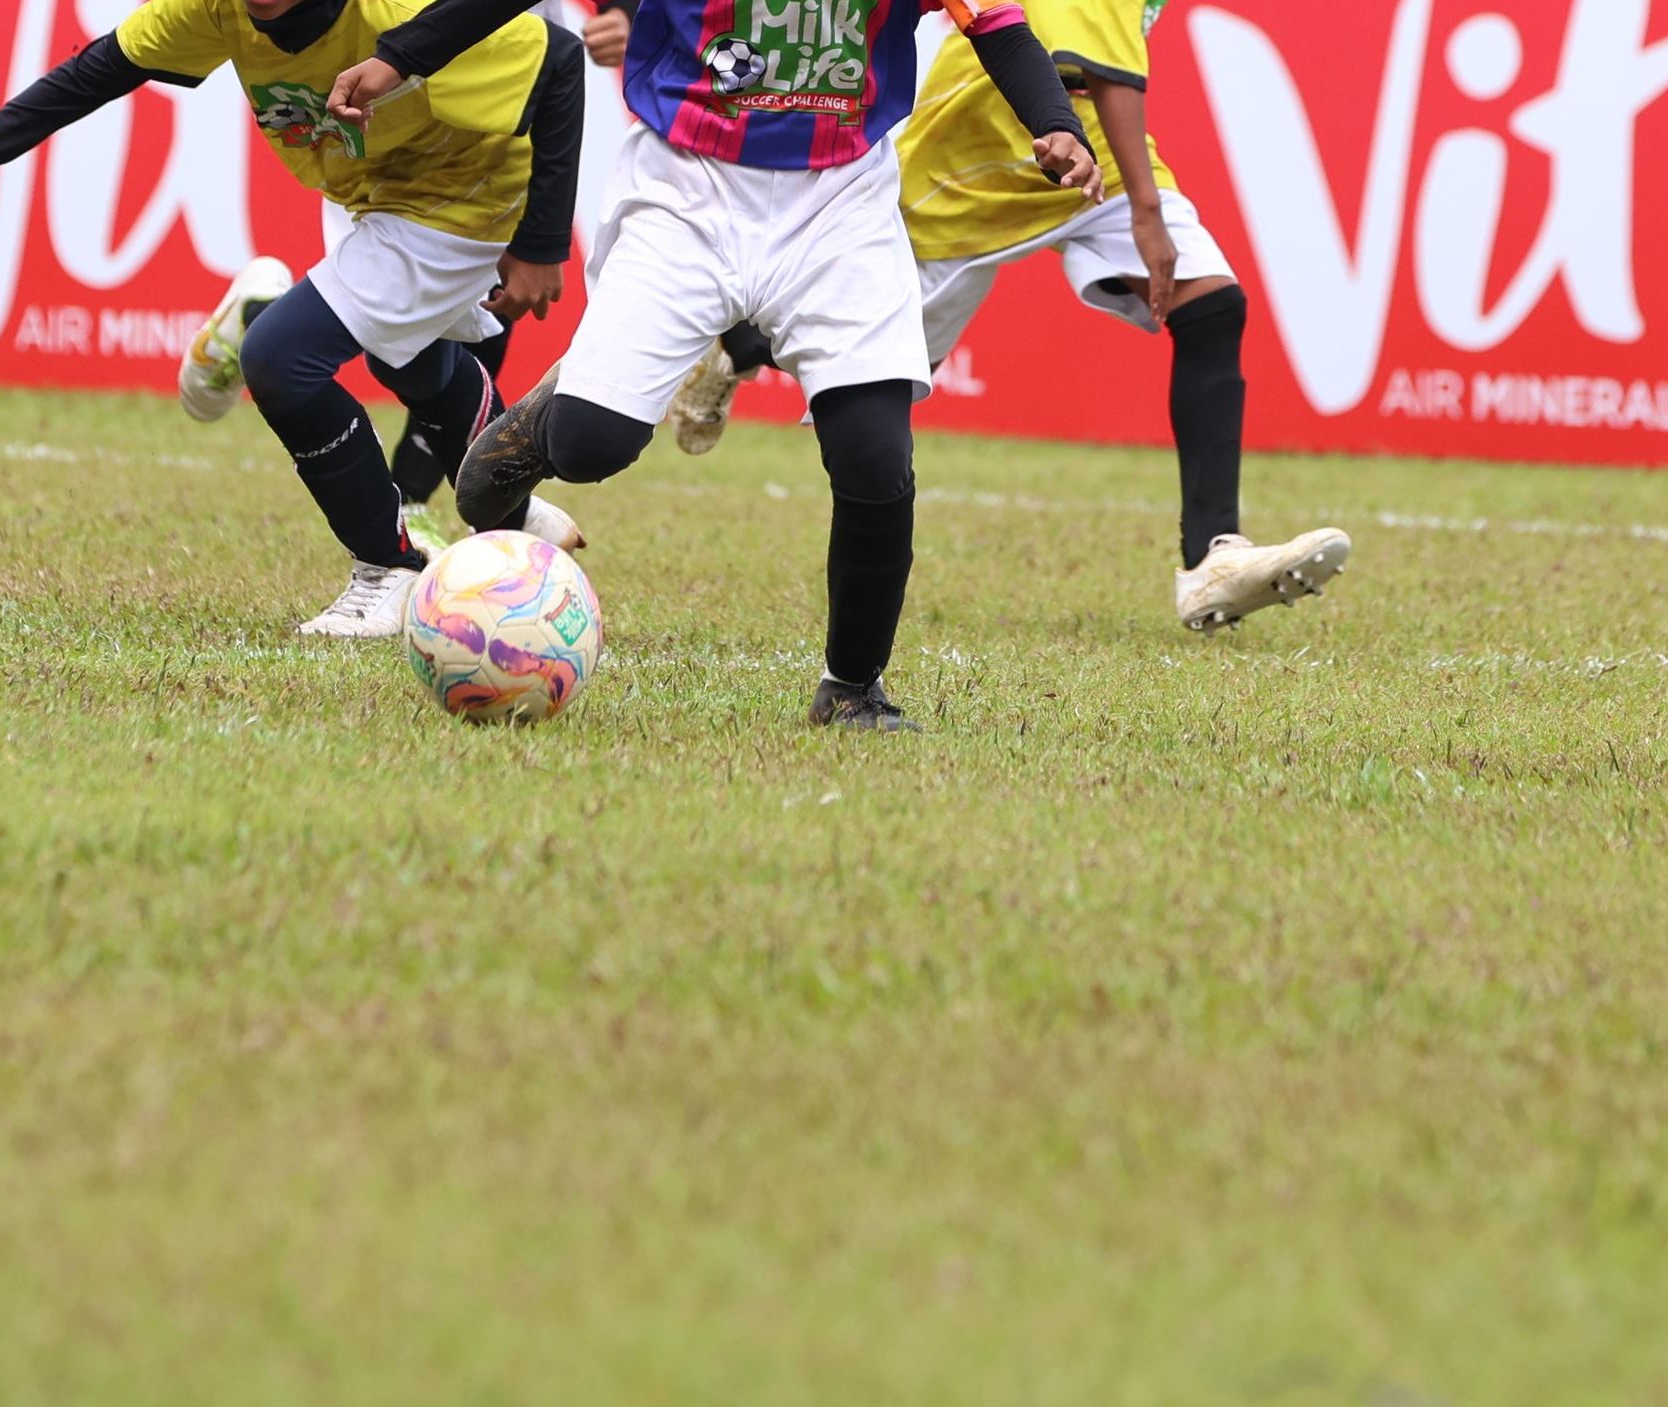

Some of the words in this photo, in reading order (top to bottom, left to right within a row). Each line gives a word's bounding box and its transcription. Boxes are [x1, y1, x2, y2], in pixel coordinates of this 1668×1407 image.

[762, 44, 864, 91] Life
[734, 95, 781, 107] SOCCER
[784, 95, 849, 110] CHALLENGE
[14, 303, 94, 356] AIR
[1379, 367, 1465, 421] AIR
